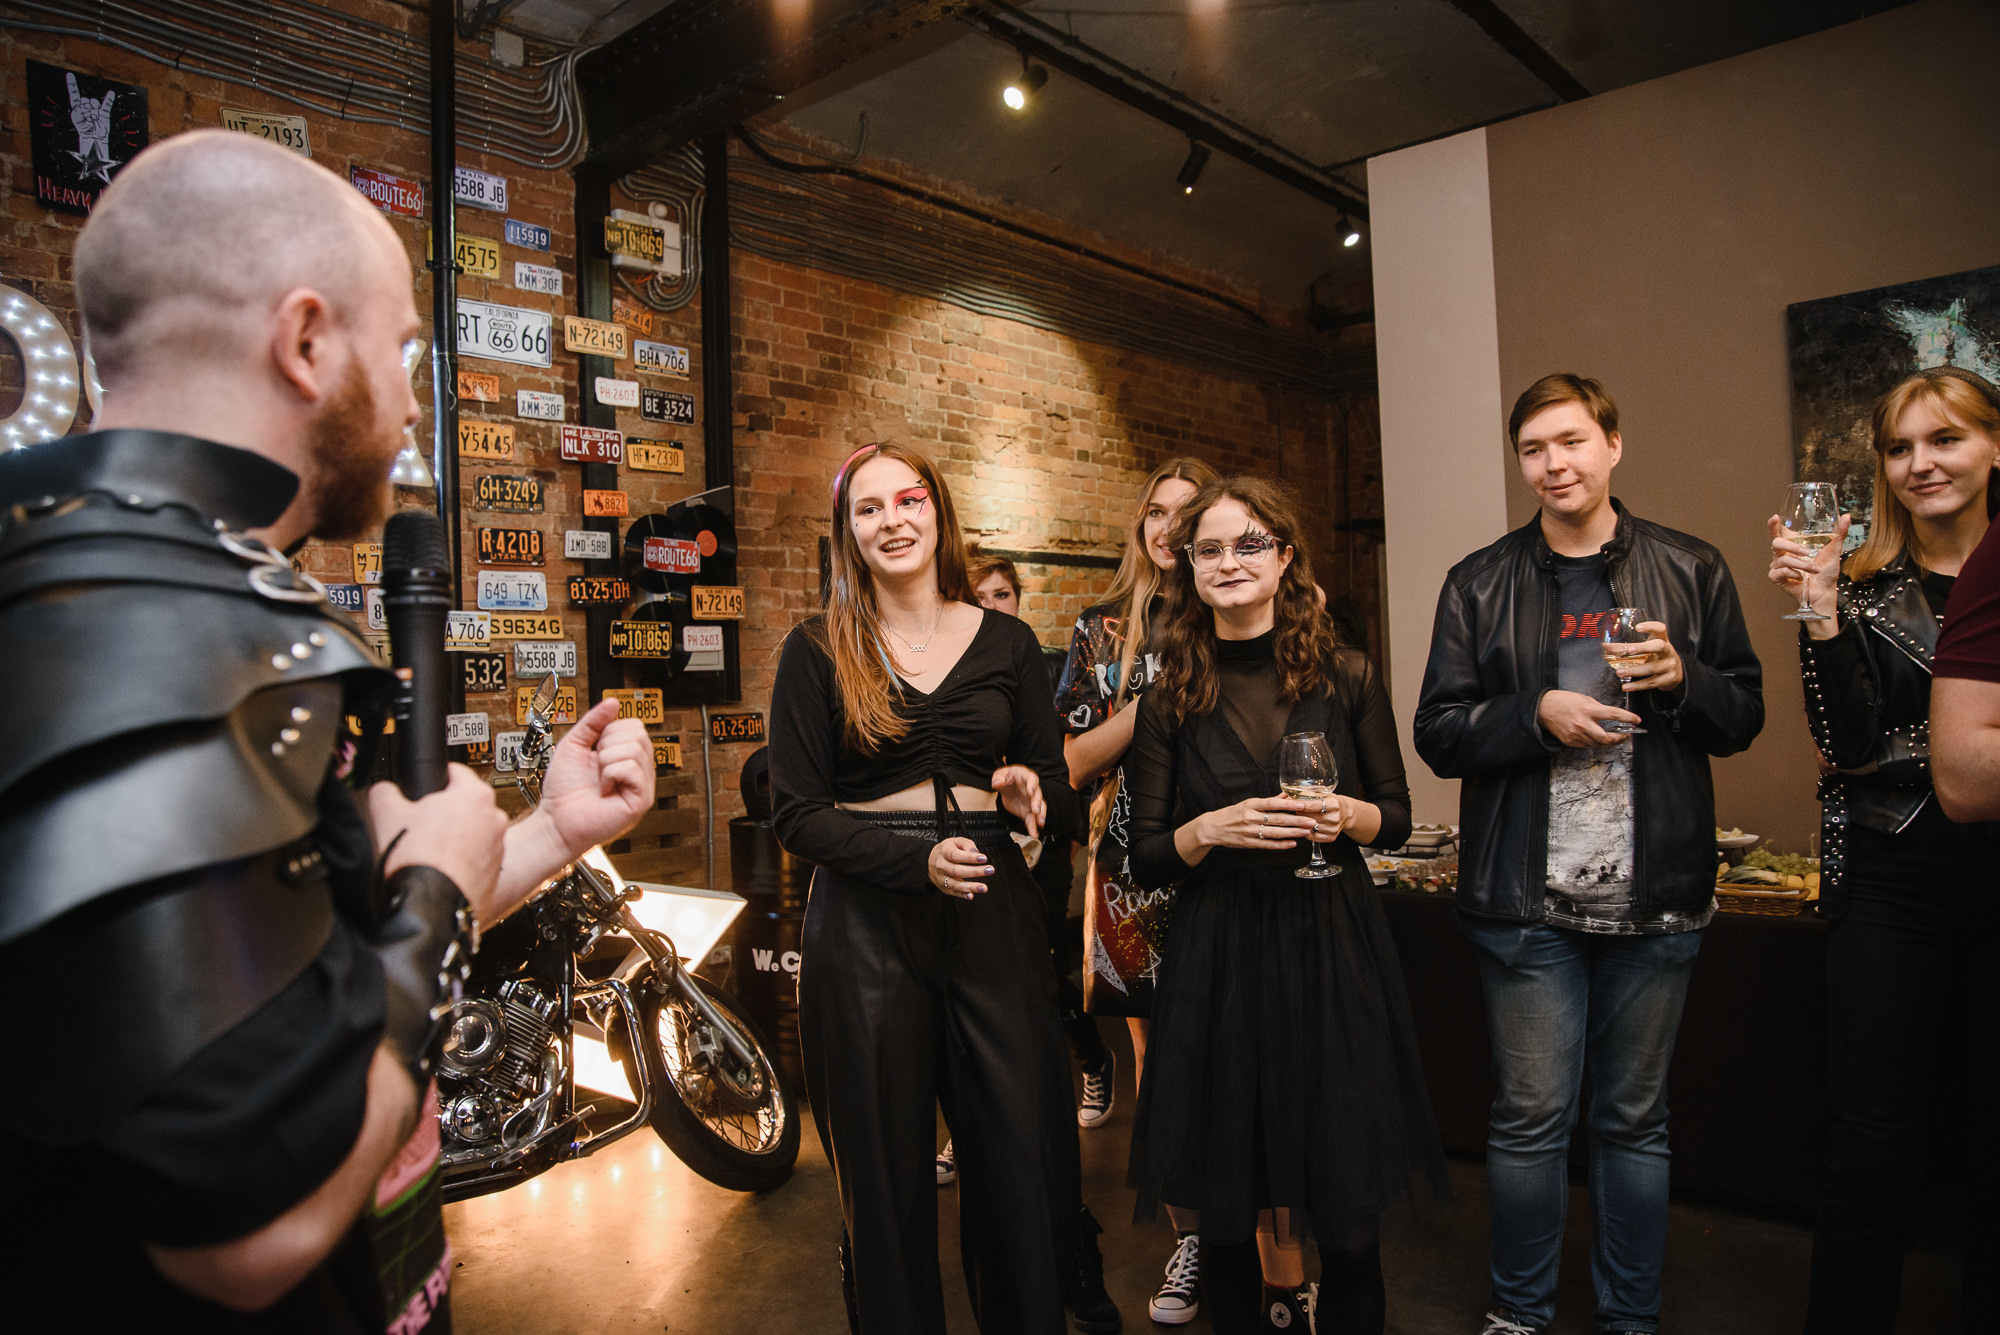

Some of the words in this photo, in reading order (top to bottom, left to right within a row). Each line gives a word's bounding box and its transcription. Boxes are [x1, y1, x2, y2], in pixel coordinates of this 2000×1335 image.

[460, 169, 488, 181] MAINE
[38, 175, 91, 214] HEAVY
[489, 185, 504, 204] JB
[485, 307, 519, 320] CALIFORNIA
[457, 312, 481, 344] RT
[521, 324, 547, 354] 66
[569, 324, 623, 351] N-72149
[640, 349, 660, 367] BHA
[664, 354, 685, 371] 706
[645, 397, 660, 414] BE
[664, 400, 692, 418] 3524
[564, 437, 590, 456] NLK
[597, 441, 620, 459] 310
[485, 582, 508, 600] 649
[516, 583, 540, 601] TZK
[696, 594, 742, 612] N-72149
[459, 623, 485, 640] 706
[623, 623, 660, 631] ARKANSAS
[612, 633, 628, 646] NR
[526, 651, 557, 669] 5588
[560, 651, 575, 668] JB
[465, 658, 503, 685] 532
[636, 700, 658, 718] 885
